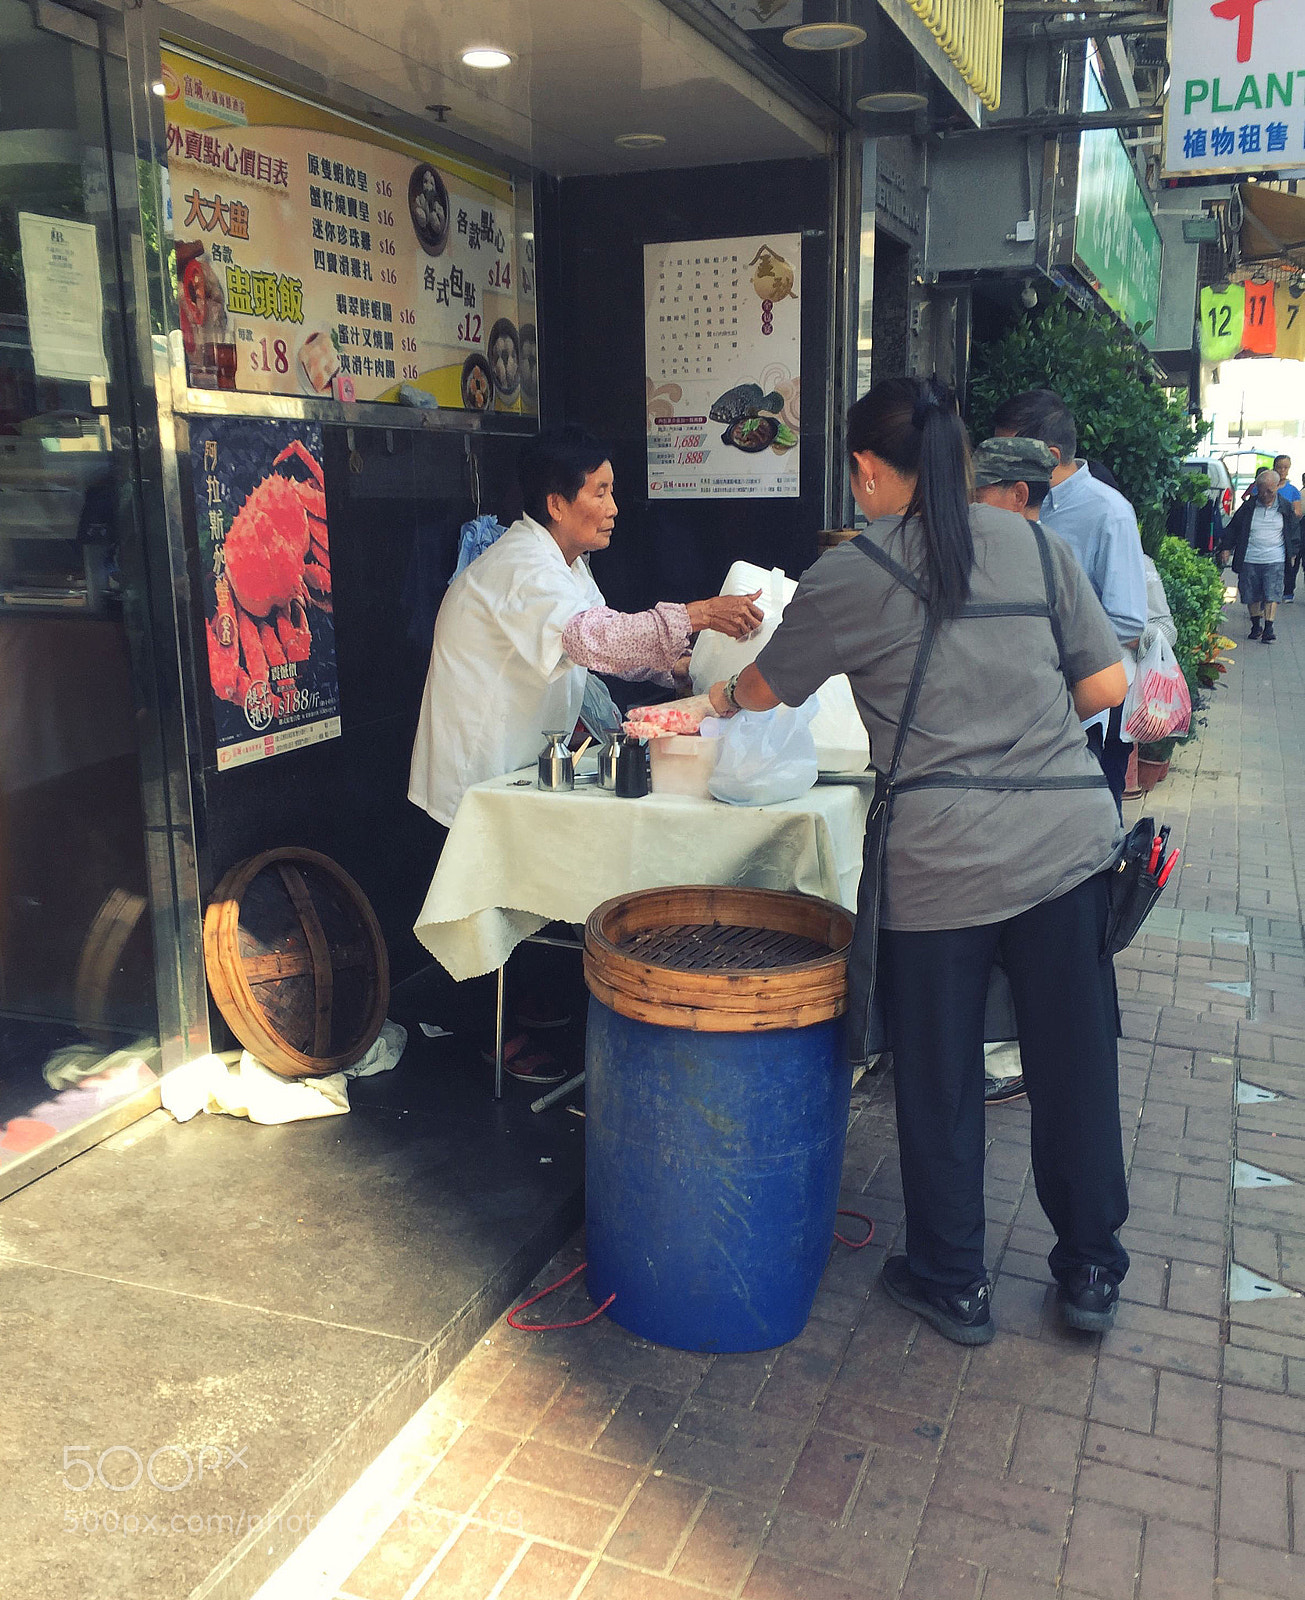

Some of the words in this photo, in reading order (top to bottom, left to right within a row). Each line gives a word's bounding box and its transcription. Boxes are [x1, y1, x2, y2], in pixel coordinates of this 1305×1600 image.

[166, 123, 289, 188] 外賣點心價目表
[1183, 122, 1289, 159] 植物租售
[376, 180, 393, 198] $16
[378, 209, 394, 227] $16
[457, 208, 505, 254] 各款點心
[311, 217, 372, 252] 迷你珍珠雞
[379, 238, 396, 256] $16
[211, 243, 234, 264] 各款
[380, 268, 397, 285] $16
[423, 263, 477, 309] 各式包點
[488, 259, 511, 290] $14
[225, 265, 304, 326] 盅頭飯
[1249, 295, 1266, 326] 11
[399, 308, 416, 325] $16
[457, 312, 482, 344] $12
[1208, 305, 1232, 337] 12
[1286, 304, 1300, 330] 7
[250, 337, 289, 374] $18
[401, 336, 417, 353] $16
[402, 364, 418, 380] $16
